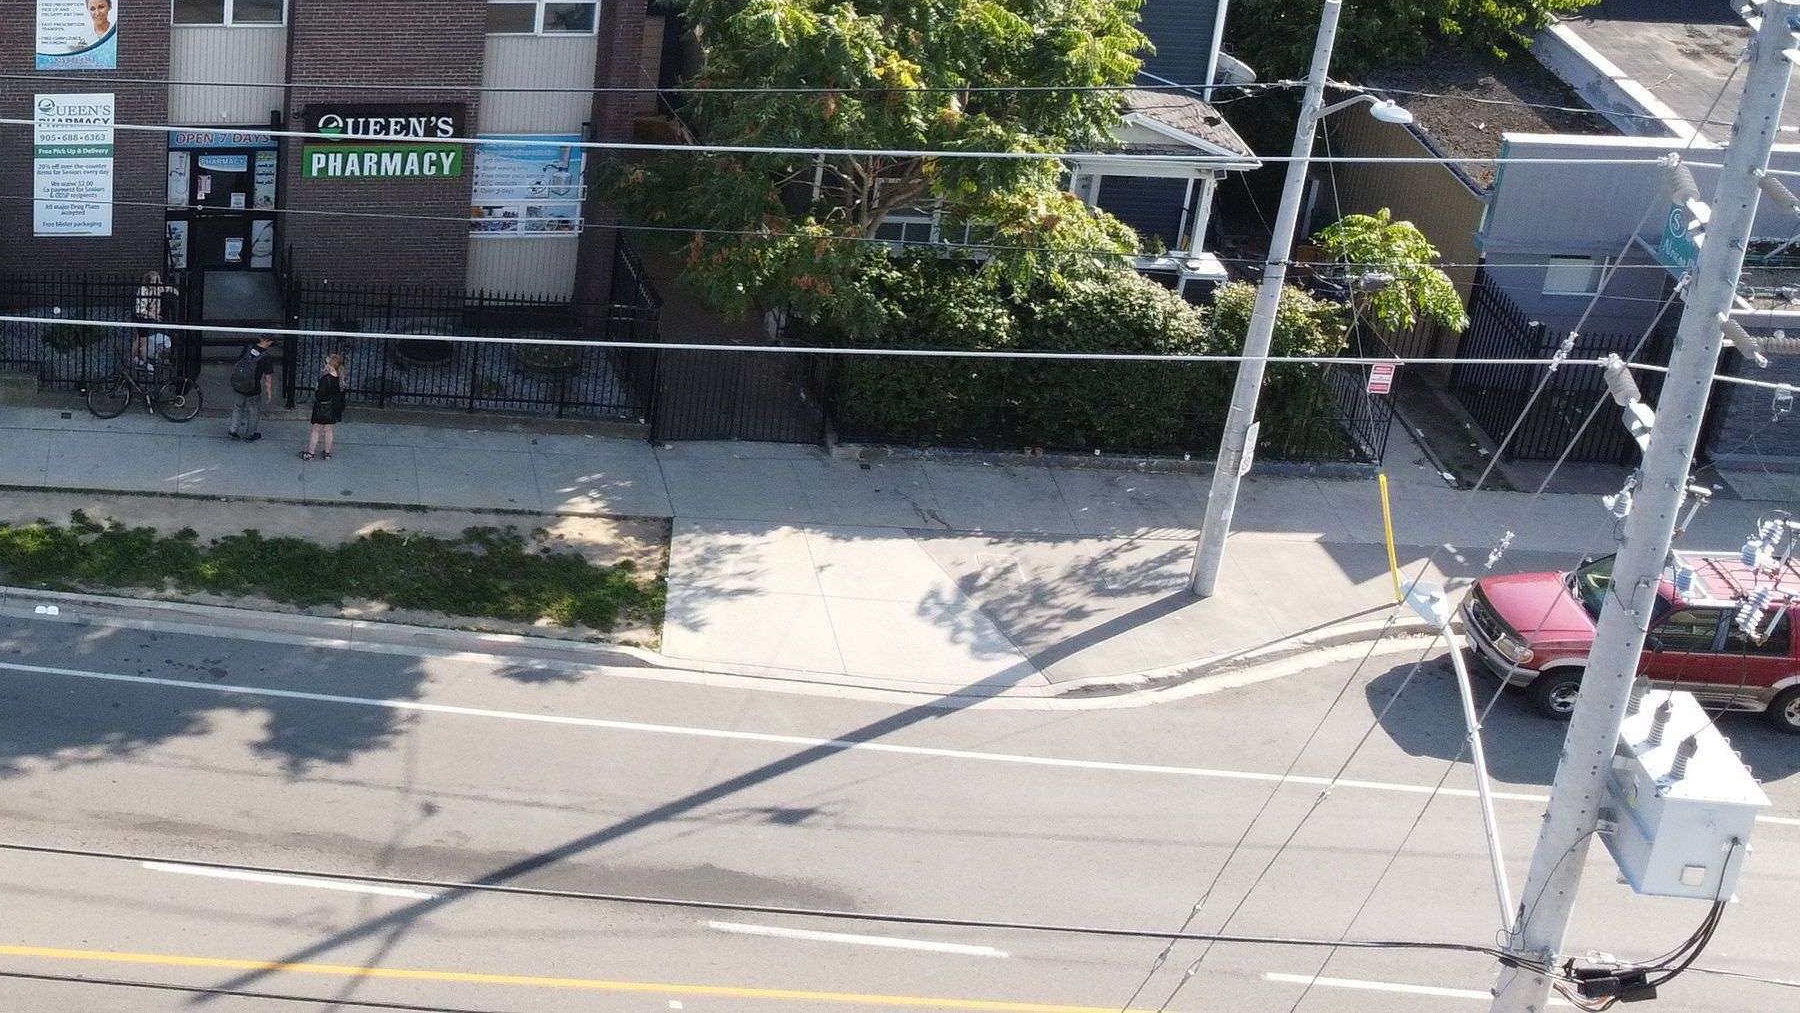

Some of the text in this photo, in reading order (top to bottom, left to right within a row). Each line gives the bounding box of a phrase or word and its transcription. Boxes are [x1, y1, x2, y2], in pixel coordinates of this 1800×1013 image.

[38, 98, 111, 116] QUEEN'S
[176, 132, 270, 143] OPEN 7 DAYS
[318, 114, 454, 140] QUEEN'S
[312, 152, 456, 176] PHARMACY
